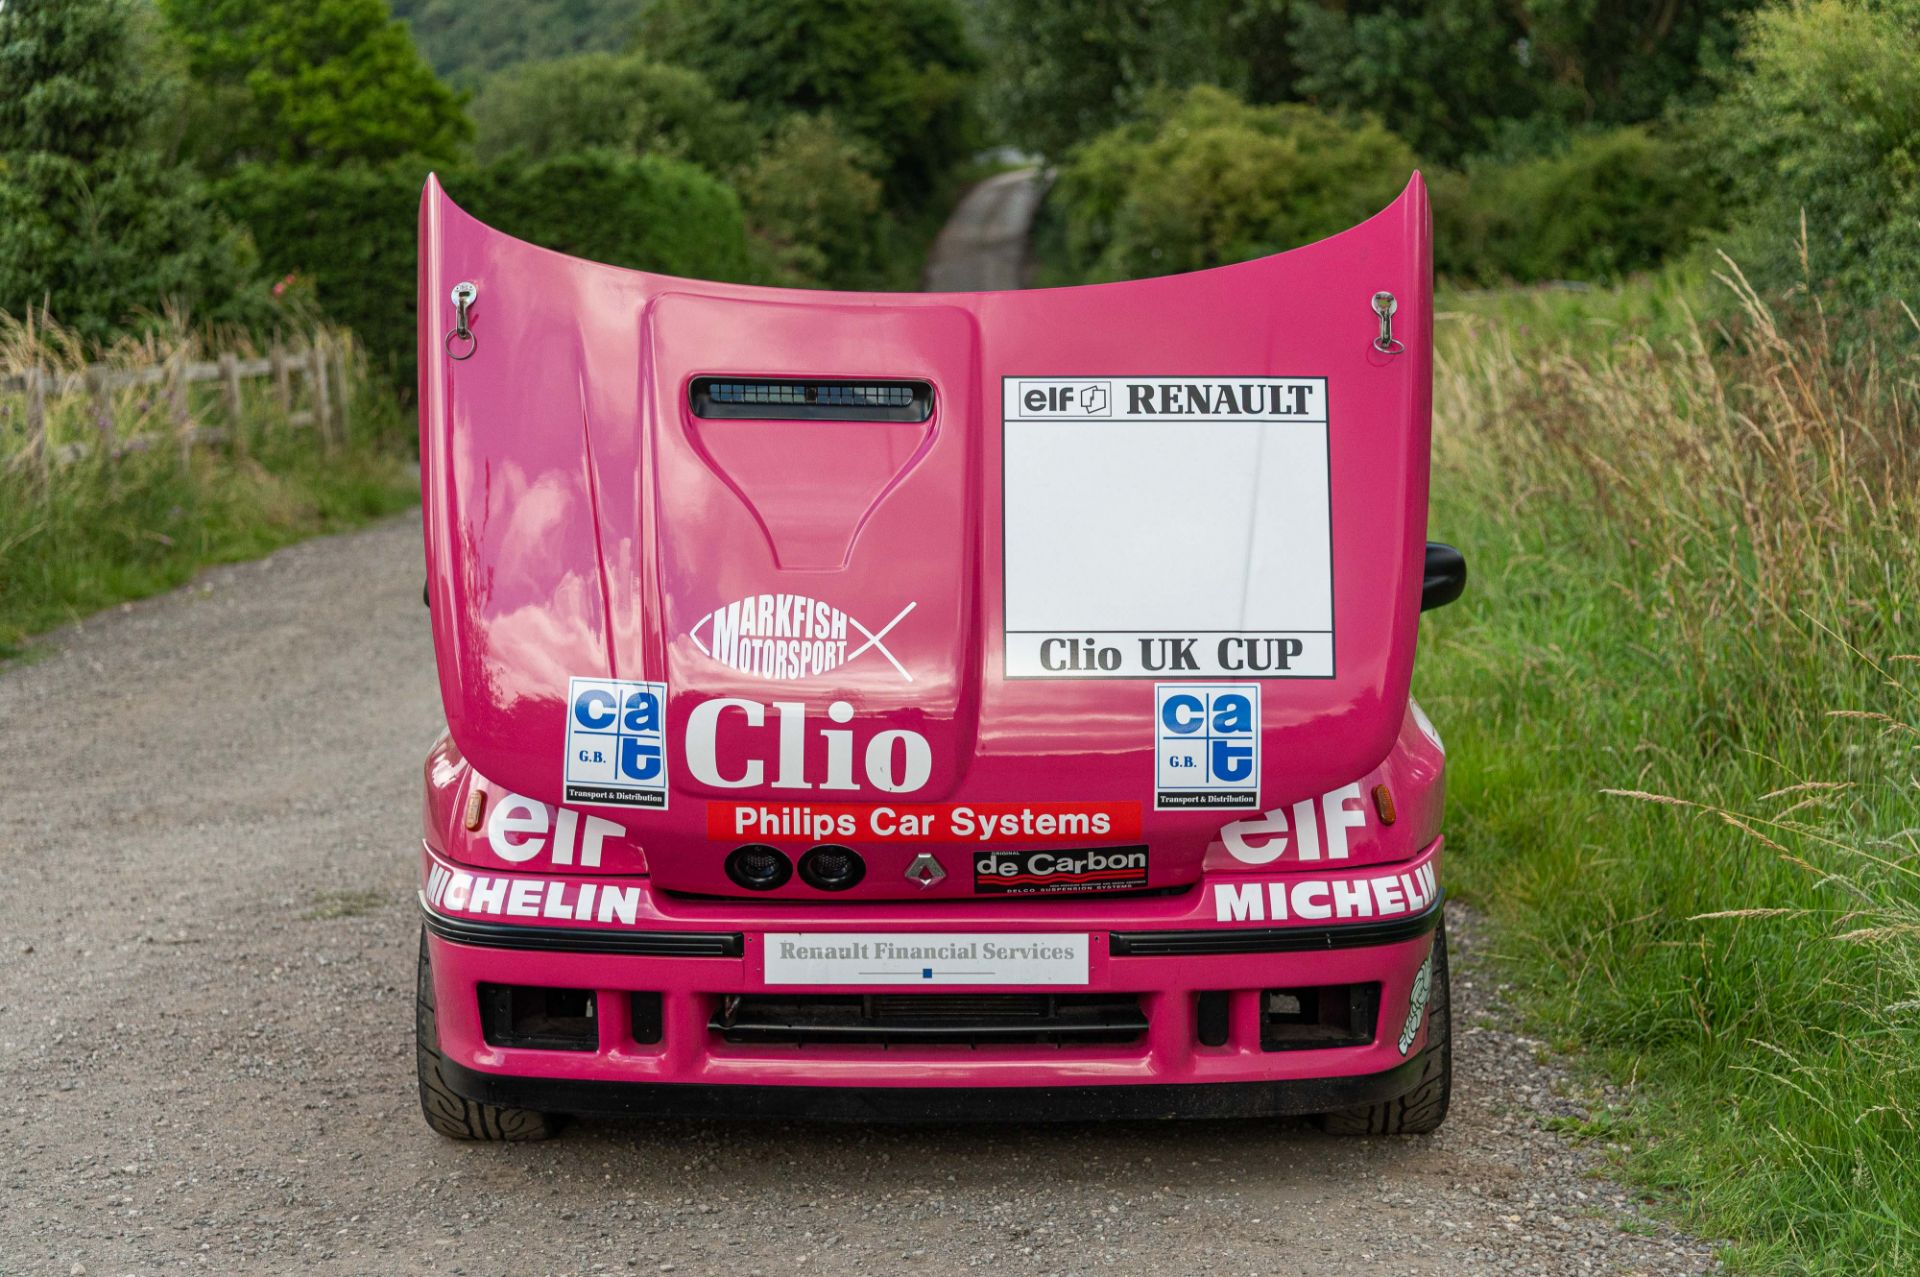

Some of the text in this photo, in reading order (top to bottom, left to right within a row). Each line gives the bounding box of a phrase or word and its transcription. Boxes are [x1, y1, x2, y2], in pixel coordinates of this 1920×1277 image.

[1023, 384, 1313, 416] elf RENAULT
[712, 594, 848, 648] MARKFISH
[712, 632, 848, 681] MOTORSPORT
[1039, 637, 1303, 671] Clio UK CUP
[579, 750, 607, 764] G.B.
[684, 698, 932, 793] Clio
[1169, 755, 1197, 769] G.B.
[569, 788, 608, 801] Transport
[616, 791, 662, 802] Distribution
[1160, 794, 1254, 805] Transport & Distribution
[735, 806, 1111, 842] Philips Car Systems
[976, 850, 1146, 877] de Carbon
[426, 860, 641, 925] MICHELIN
[1214, 859, 1438, 923] MICHELIN
[779, 941, 1075, 961] Renault Financial Services
